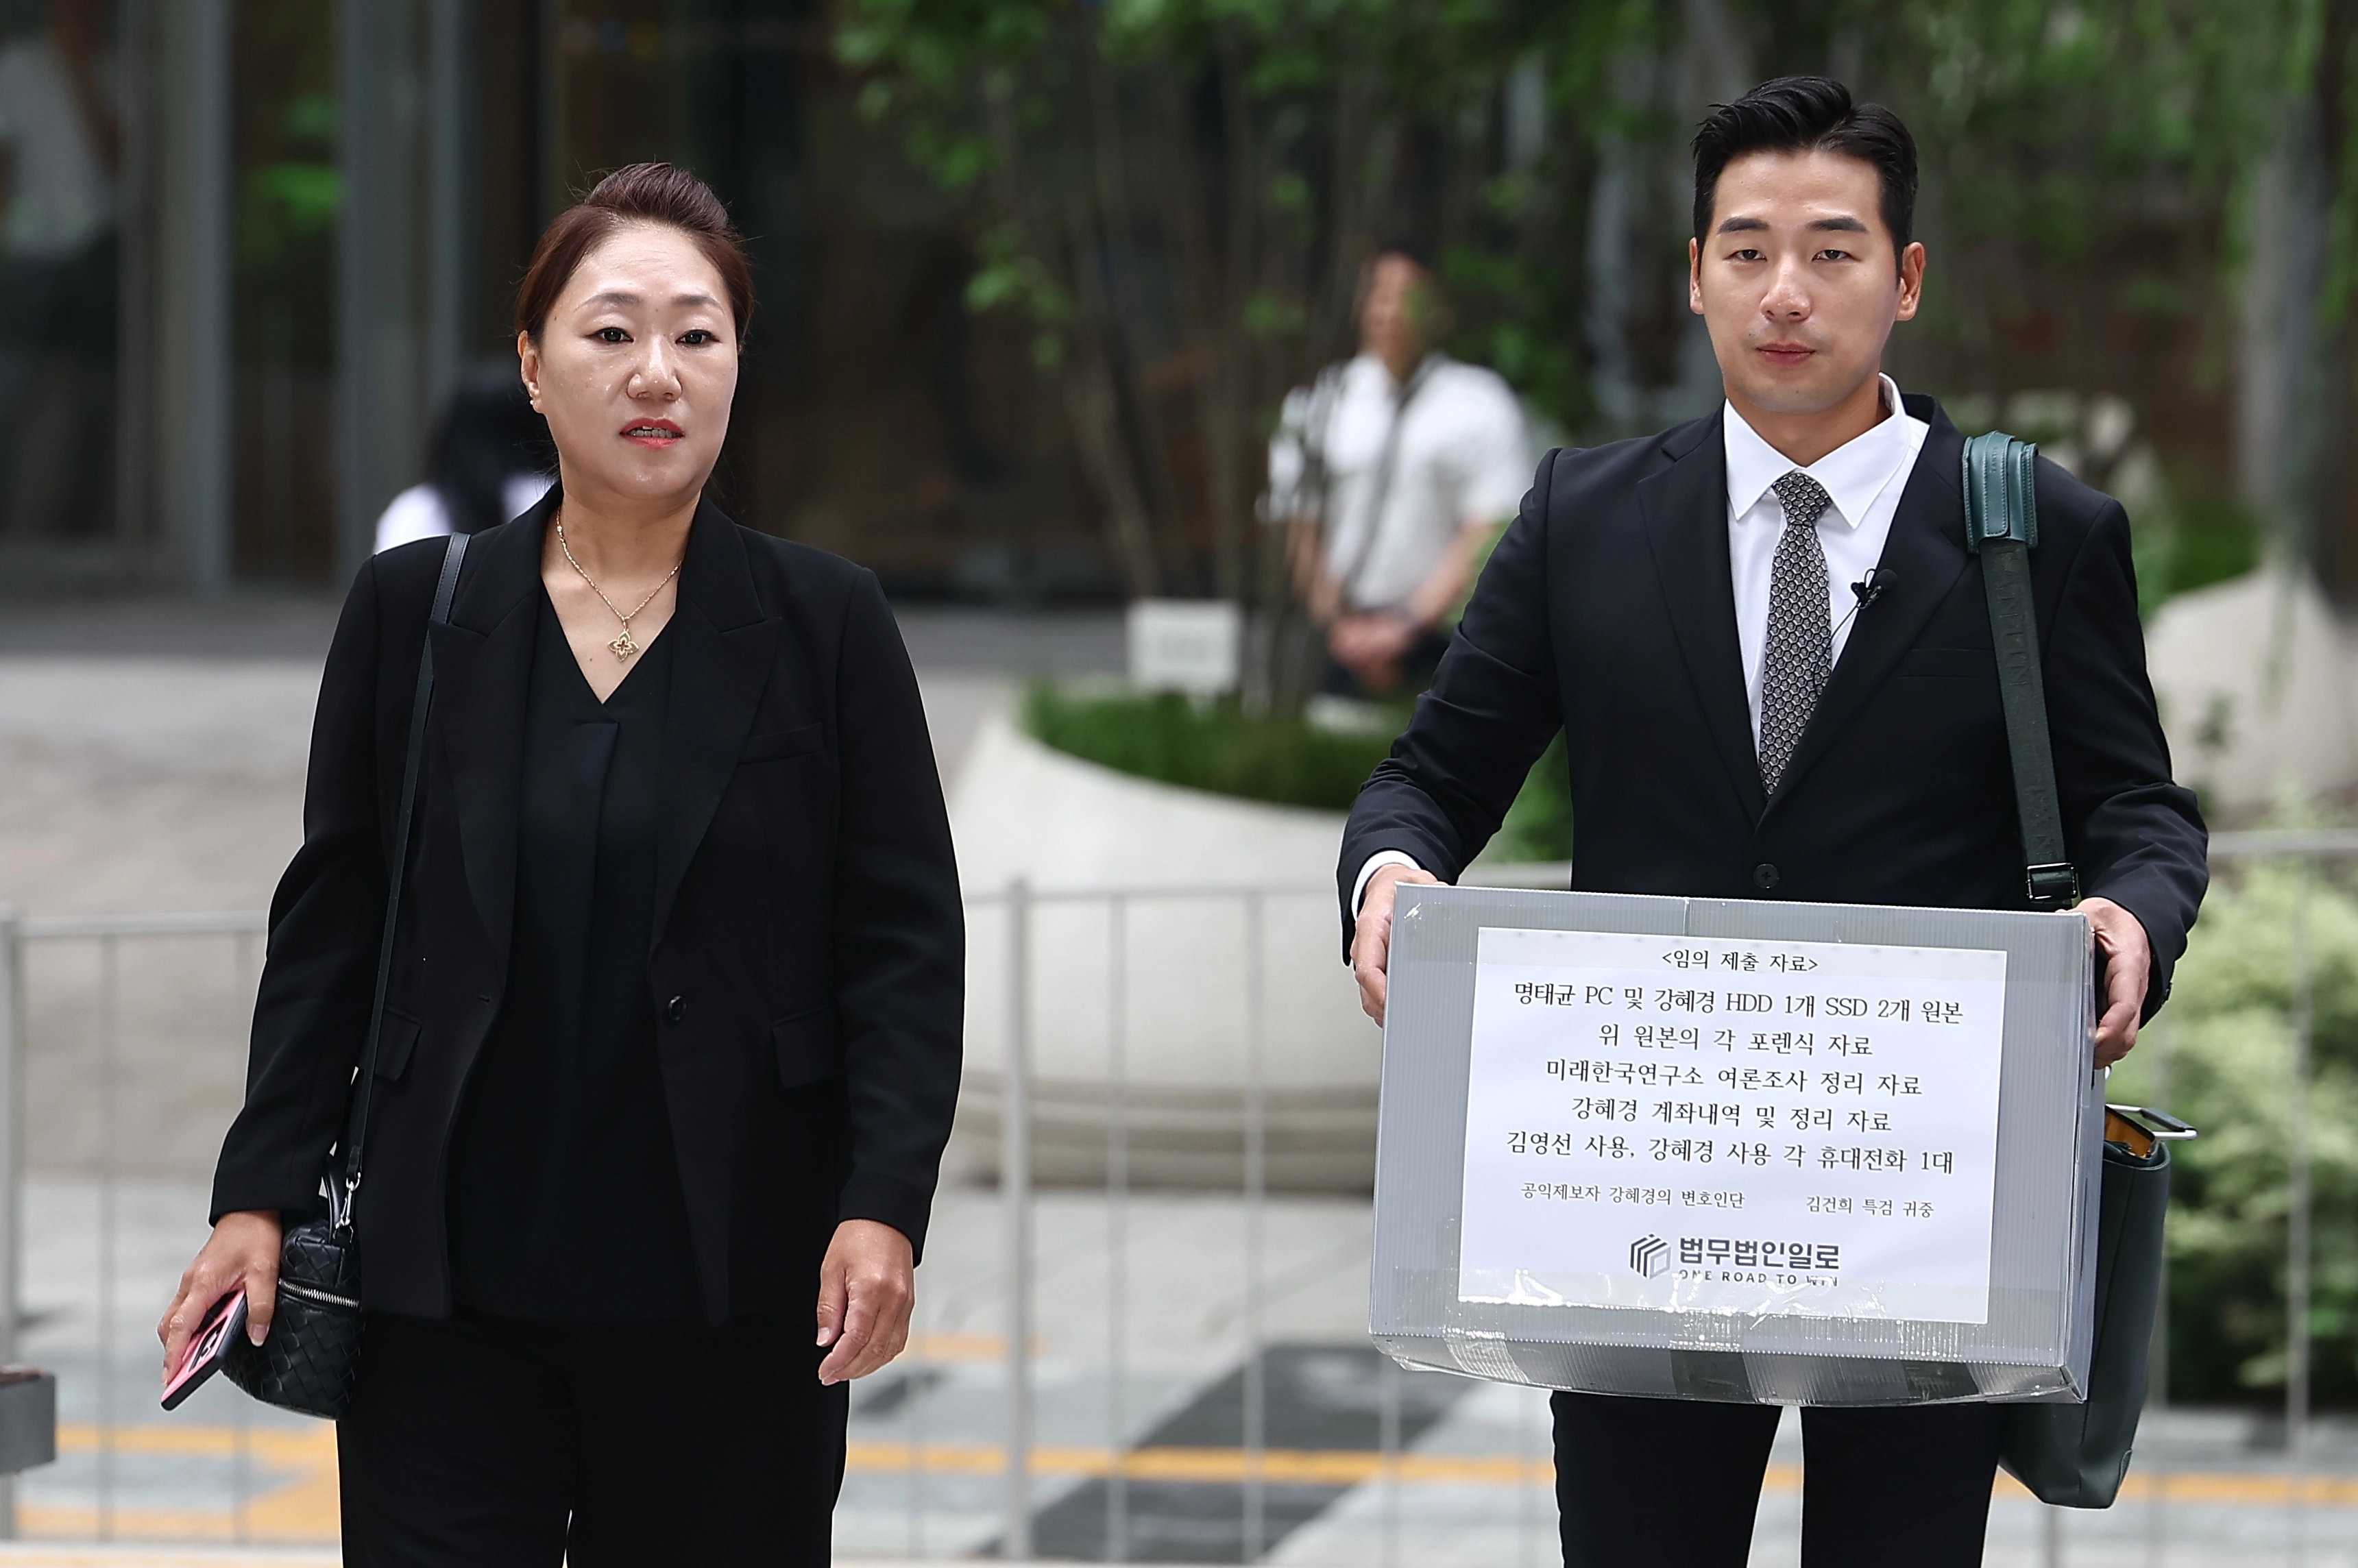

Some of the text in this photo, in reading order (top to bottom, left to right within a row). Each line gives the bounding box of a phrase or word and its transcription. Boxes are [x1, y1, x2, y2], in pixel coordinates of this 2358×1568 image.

[1661, 948, 1819, 975] <임의 제출 자료>
[1514, 981, 1965, 1025] 명태균 PC 및 강혜경 HDD 1개 SSD 2개 원본
[1598, 1022, 1874, 1058] 위 원본의 각 포렌식 자료
[1546, 1057, 1923, 1098] 미래한국연구소 여론조사 정리 자료
[1570, 1096, 1893, 1134] 강혜경 계좌내역 및 정리 자료
[1506, 1129, 1954, 1176] 김영선 사용, 강혜경 사용 각 휴대전화 1대
[1520, 1181, 1746, 1210] 공익제보자 강혜경의 변호인단
[1806, 1195, 1935, 1219] 김건희 특검 귀중
[1679, 1236, 1840, 1271] 법무법인일로
[1678, 1268, 1713, 1282] ONE
[1721, 1270, 1768, 1284] ROAD
[1775, 1273, 1798, 1286] TO
